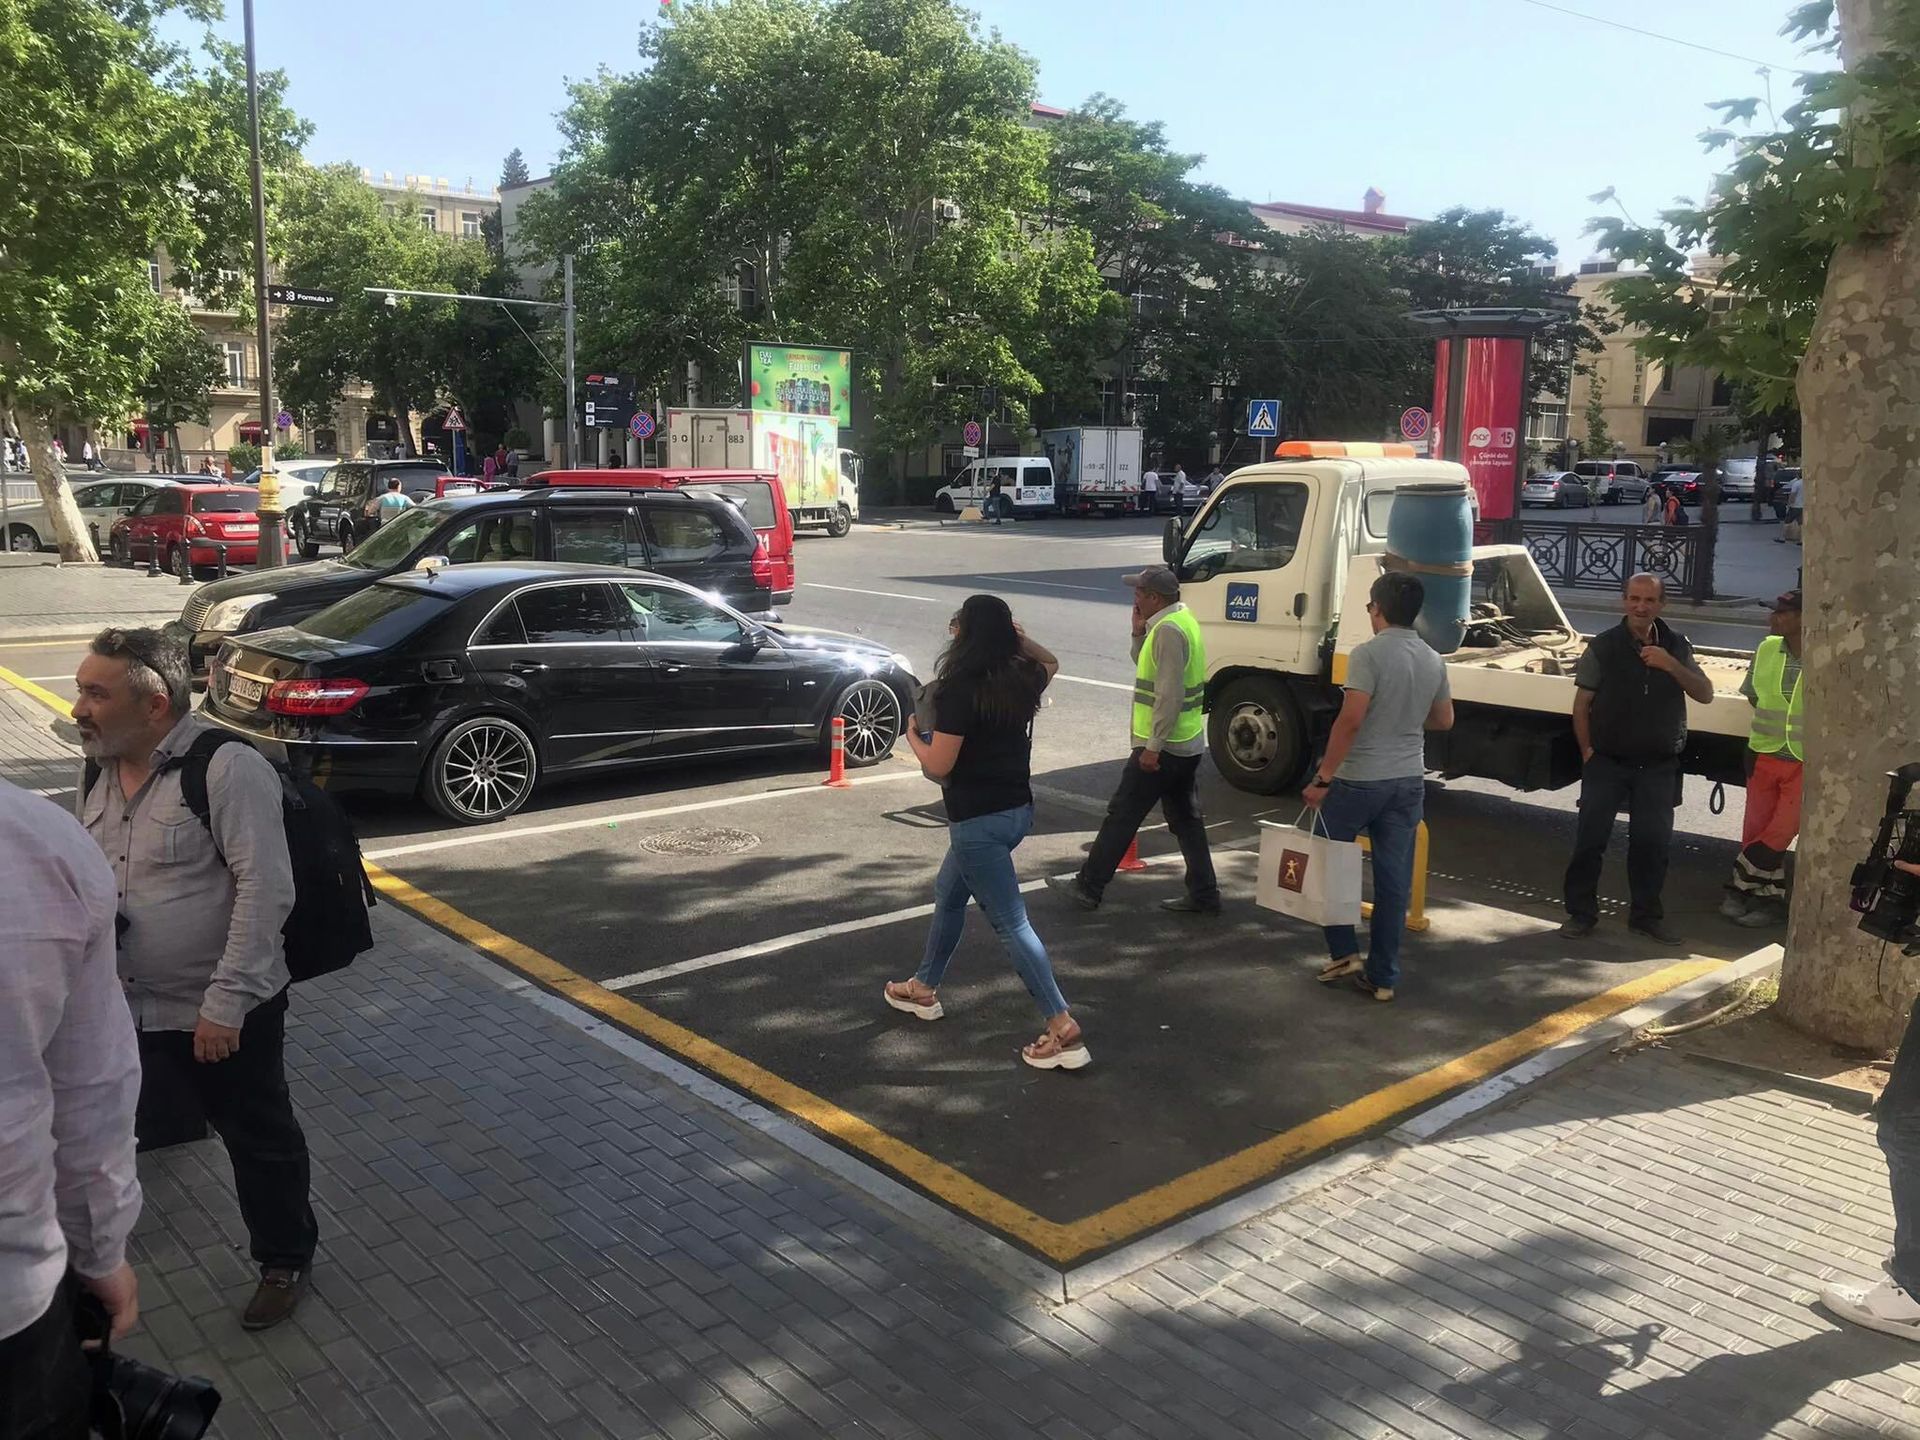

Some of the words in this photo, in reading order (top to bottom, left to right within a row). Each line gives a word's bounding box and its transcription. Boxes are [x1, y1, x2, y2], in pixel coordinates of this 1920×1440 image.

[297, 293, 325, 303] Formula
[728, 434, 744, 443] 883
[1471, 433, 1489, 441] nar
